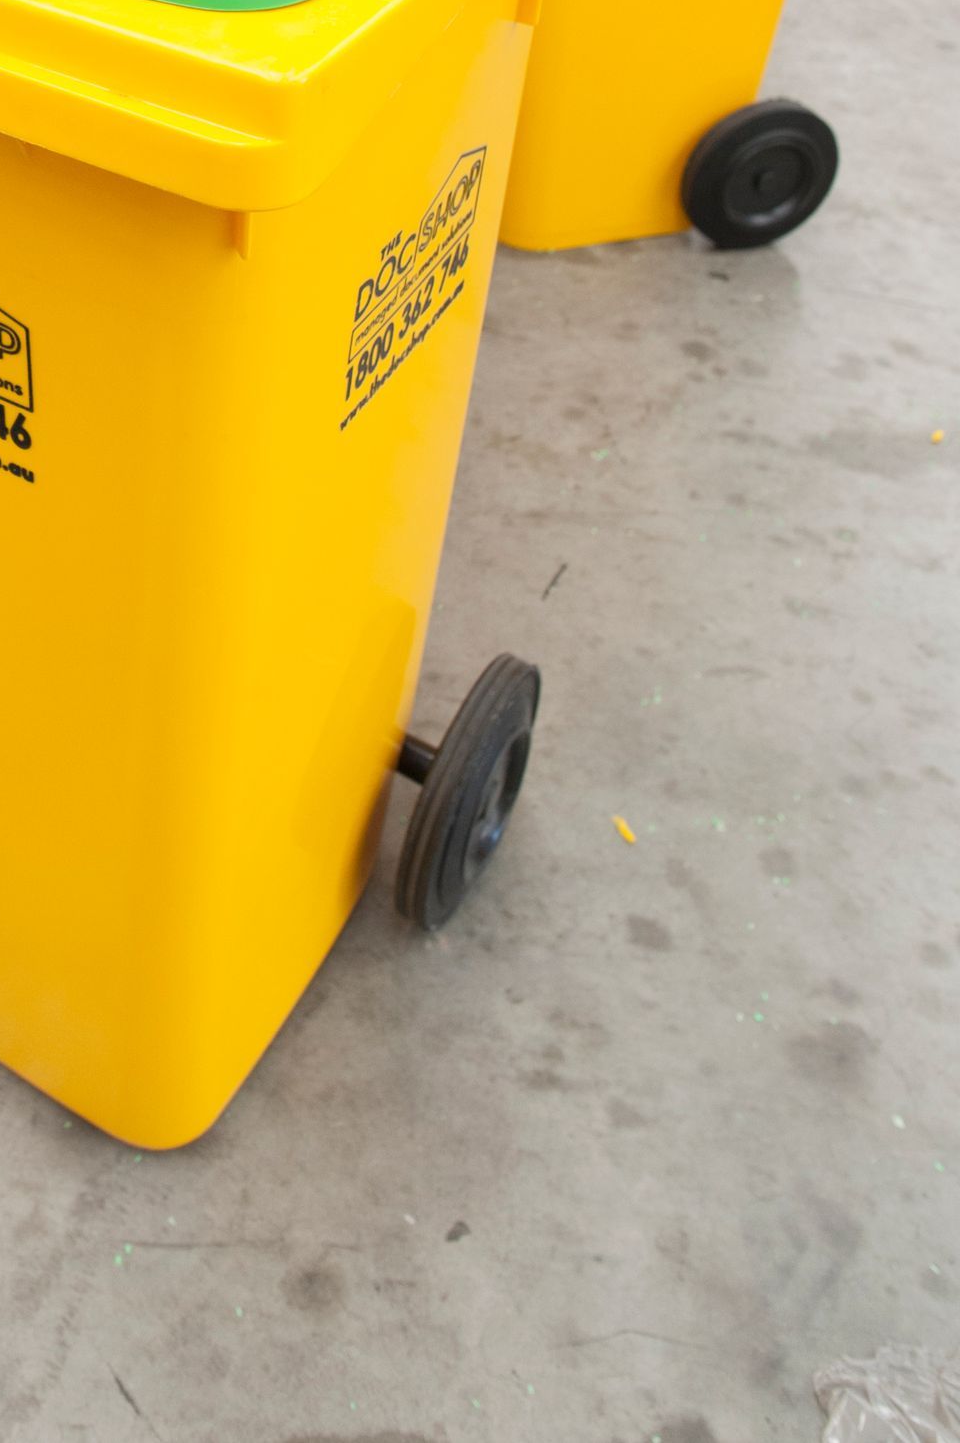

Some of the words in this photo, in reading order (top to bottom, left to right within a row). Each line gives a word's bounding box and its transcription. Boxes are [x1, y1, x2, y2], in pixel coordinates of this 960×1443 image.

[345, 321, 394, 402] 1800
[398, 275, 435, 340] 362
[439, 233, 470, 294] 746
[354, 233, 417, 323] DOC
[419, 159, 481, 252] SHOP
[380, 230, 403, 262] THE
